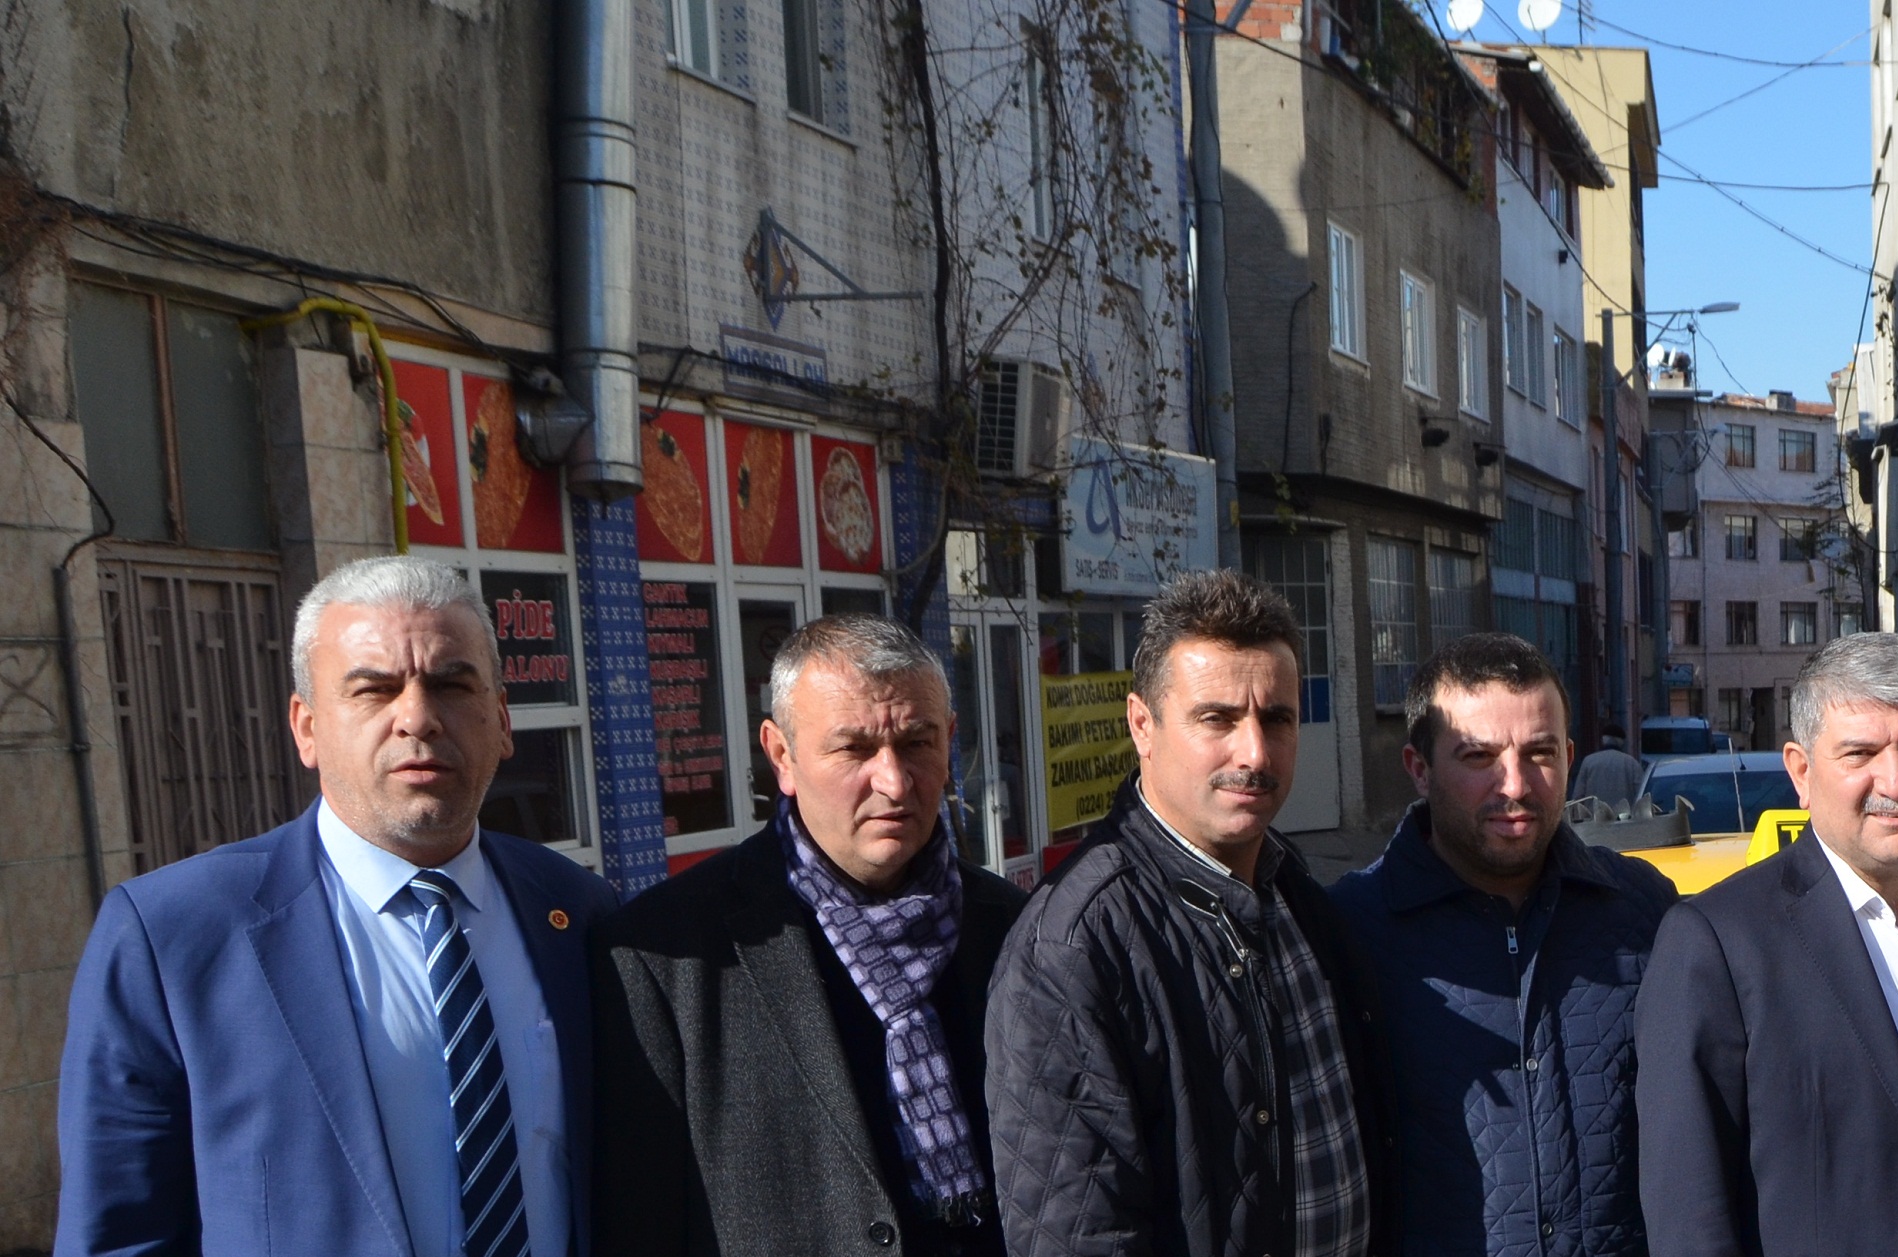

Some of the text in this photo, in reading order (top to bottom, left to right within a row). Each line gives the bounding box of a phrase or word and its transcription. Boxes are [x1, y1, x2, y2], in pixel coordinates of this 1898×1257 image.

[496, 588, 556, 640] PİDE
[503, 655, 569, 683] ALONU
[1074, 678, 1127, 707] DOĞALGAZ
[1048, 720, 1085, 749] BAKIMI
[1083, 717, 1118, 745] PETEK
[1051, 758, 1093, 788] ZAMANI
[1076, 791, 1104, 822] (0224)
